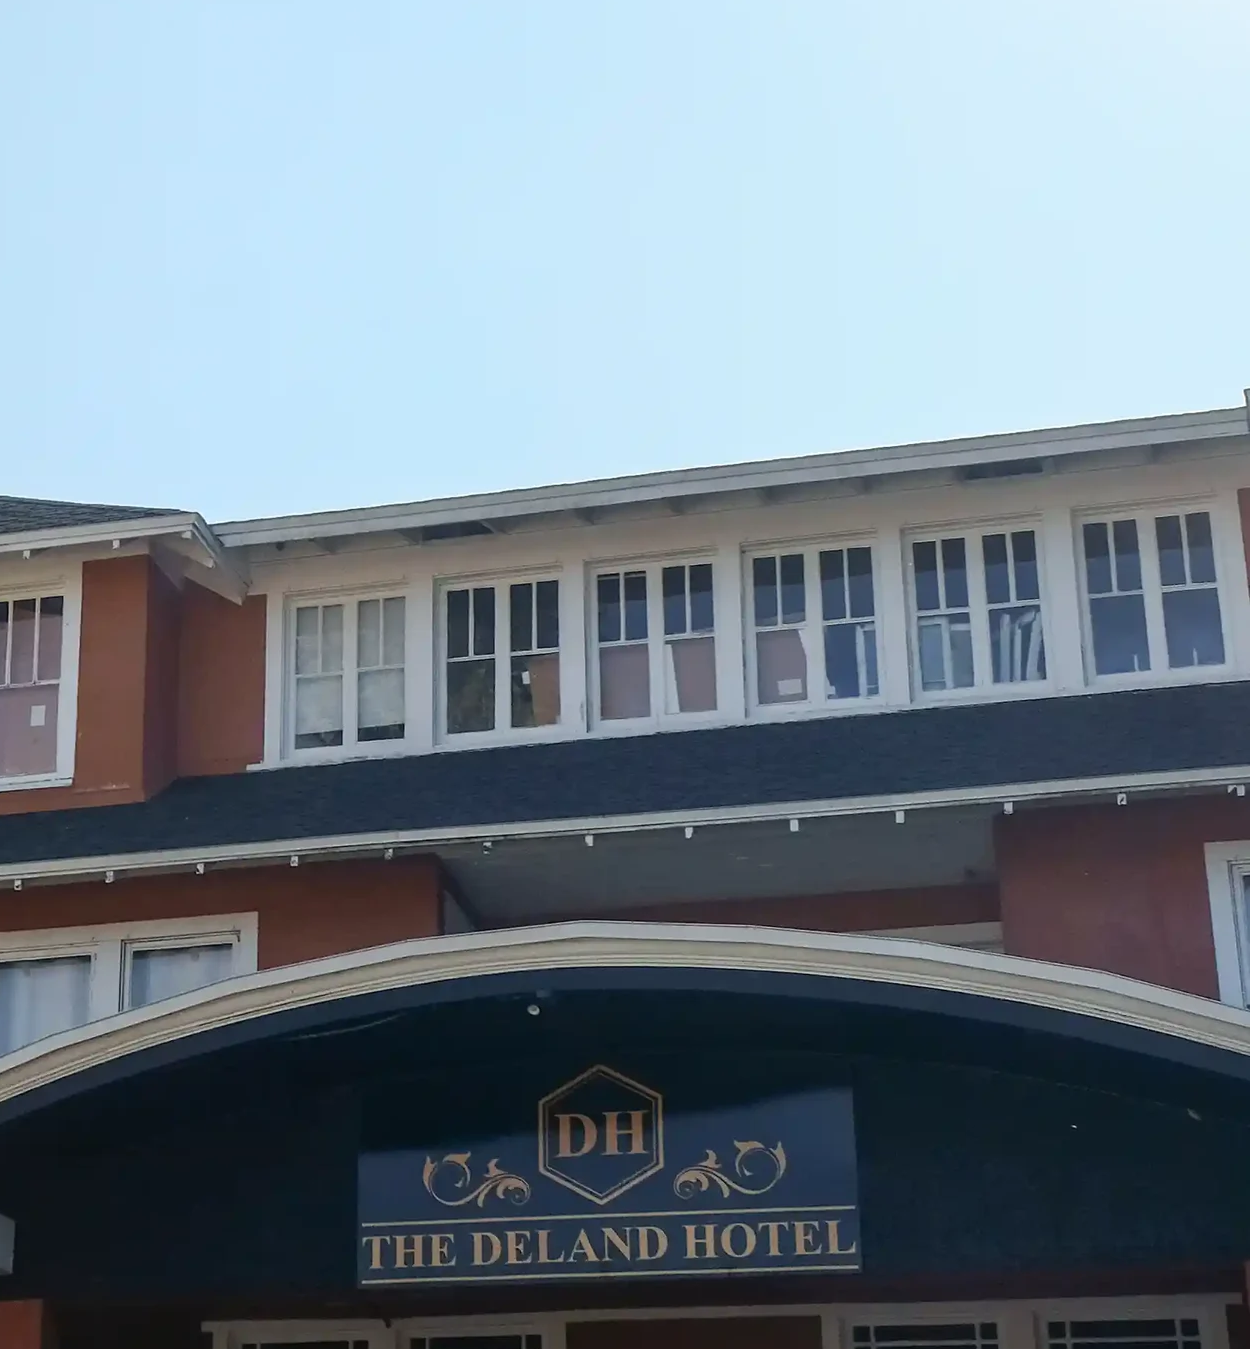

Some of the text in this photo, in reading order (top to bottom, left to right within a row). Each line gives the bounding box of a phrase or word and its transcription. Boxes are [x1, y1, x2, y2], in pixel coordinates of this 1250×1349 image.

[554, 1110, 649, 1158] DH
[362, 1220, 857, 1270] THE DELAND HOTEL
